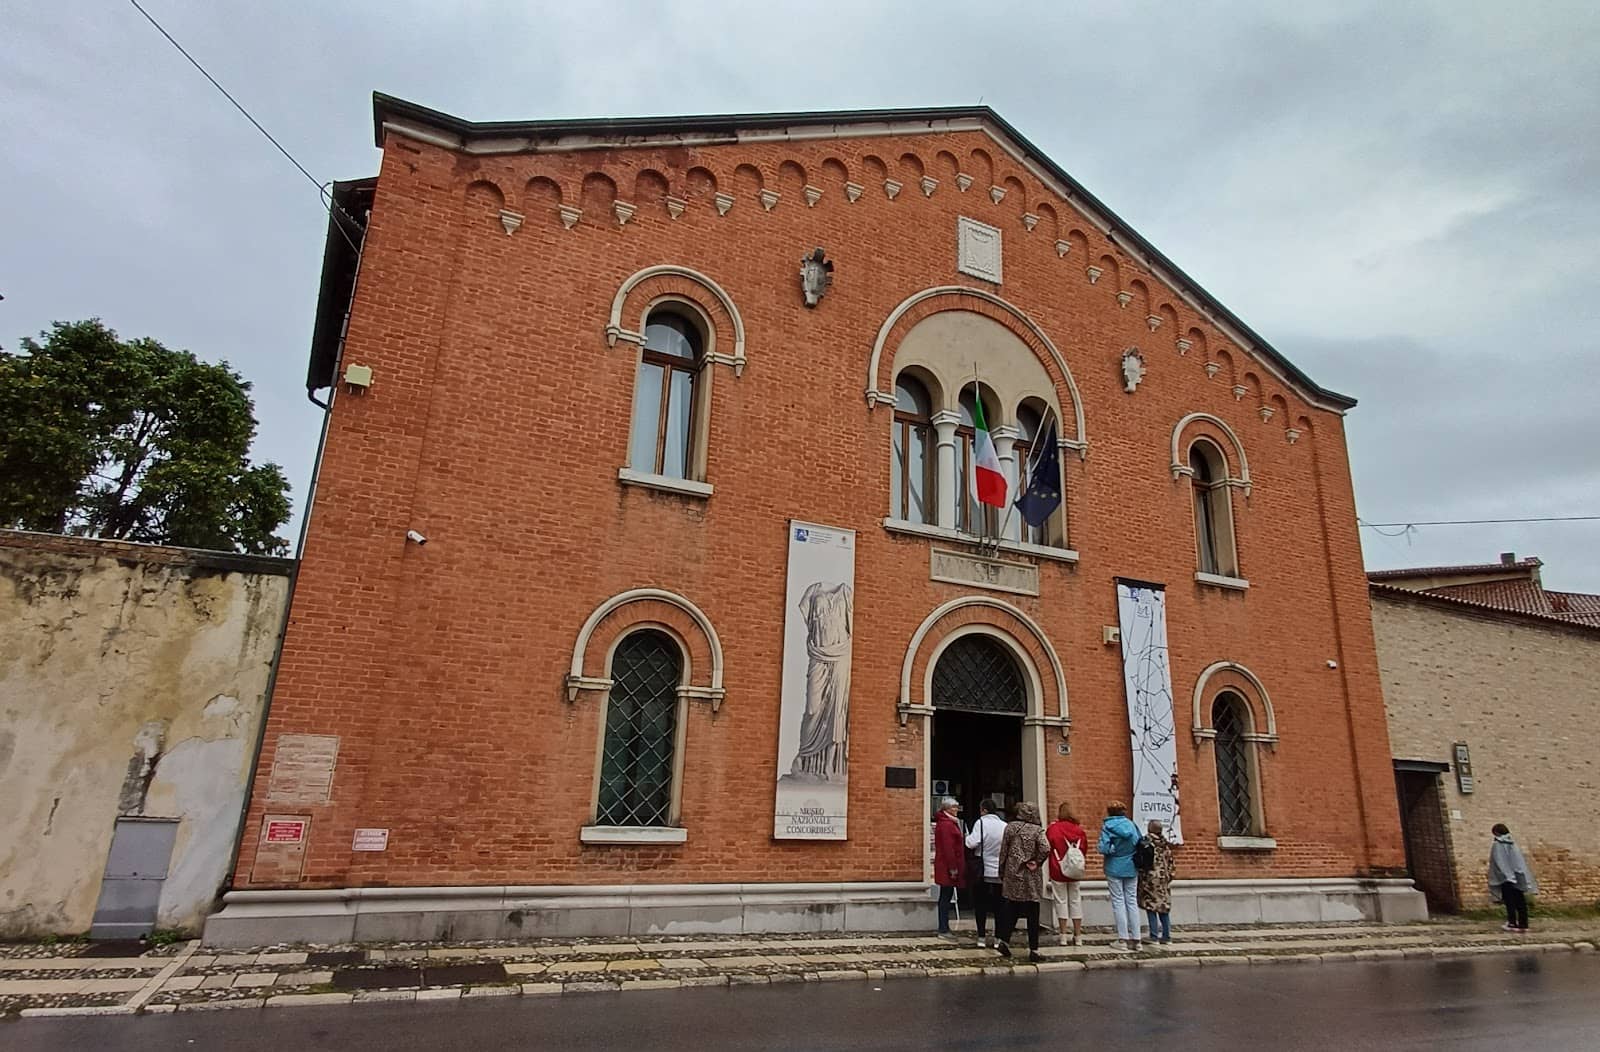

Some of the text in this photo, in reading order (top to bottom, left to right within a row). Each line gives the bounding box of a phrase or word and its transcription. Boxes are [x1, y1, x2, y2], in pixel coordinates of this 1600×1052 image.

[799, 807, 825, 816] MUSEO
[1140, 801, 1172, 813] LEVITAS
[791, 816, 831, 825] NAZIONALE
